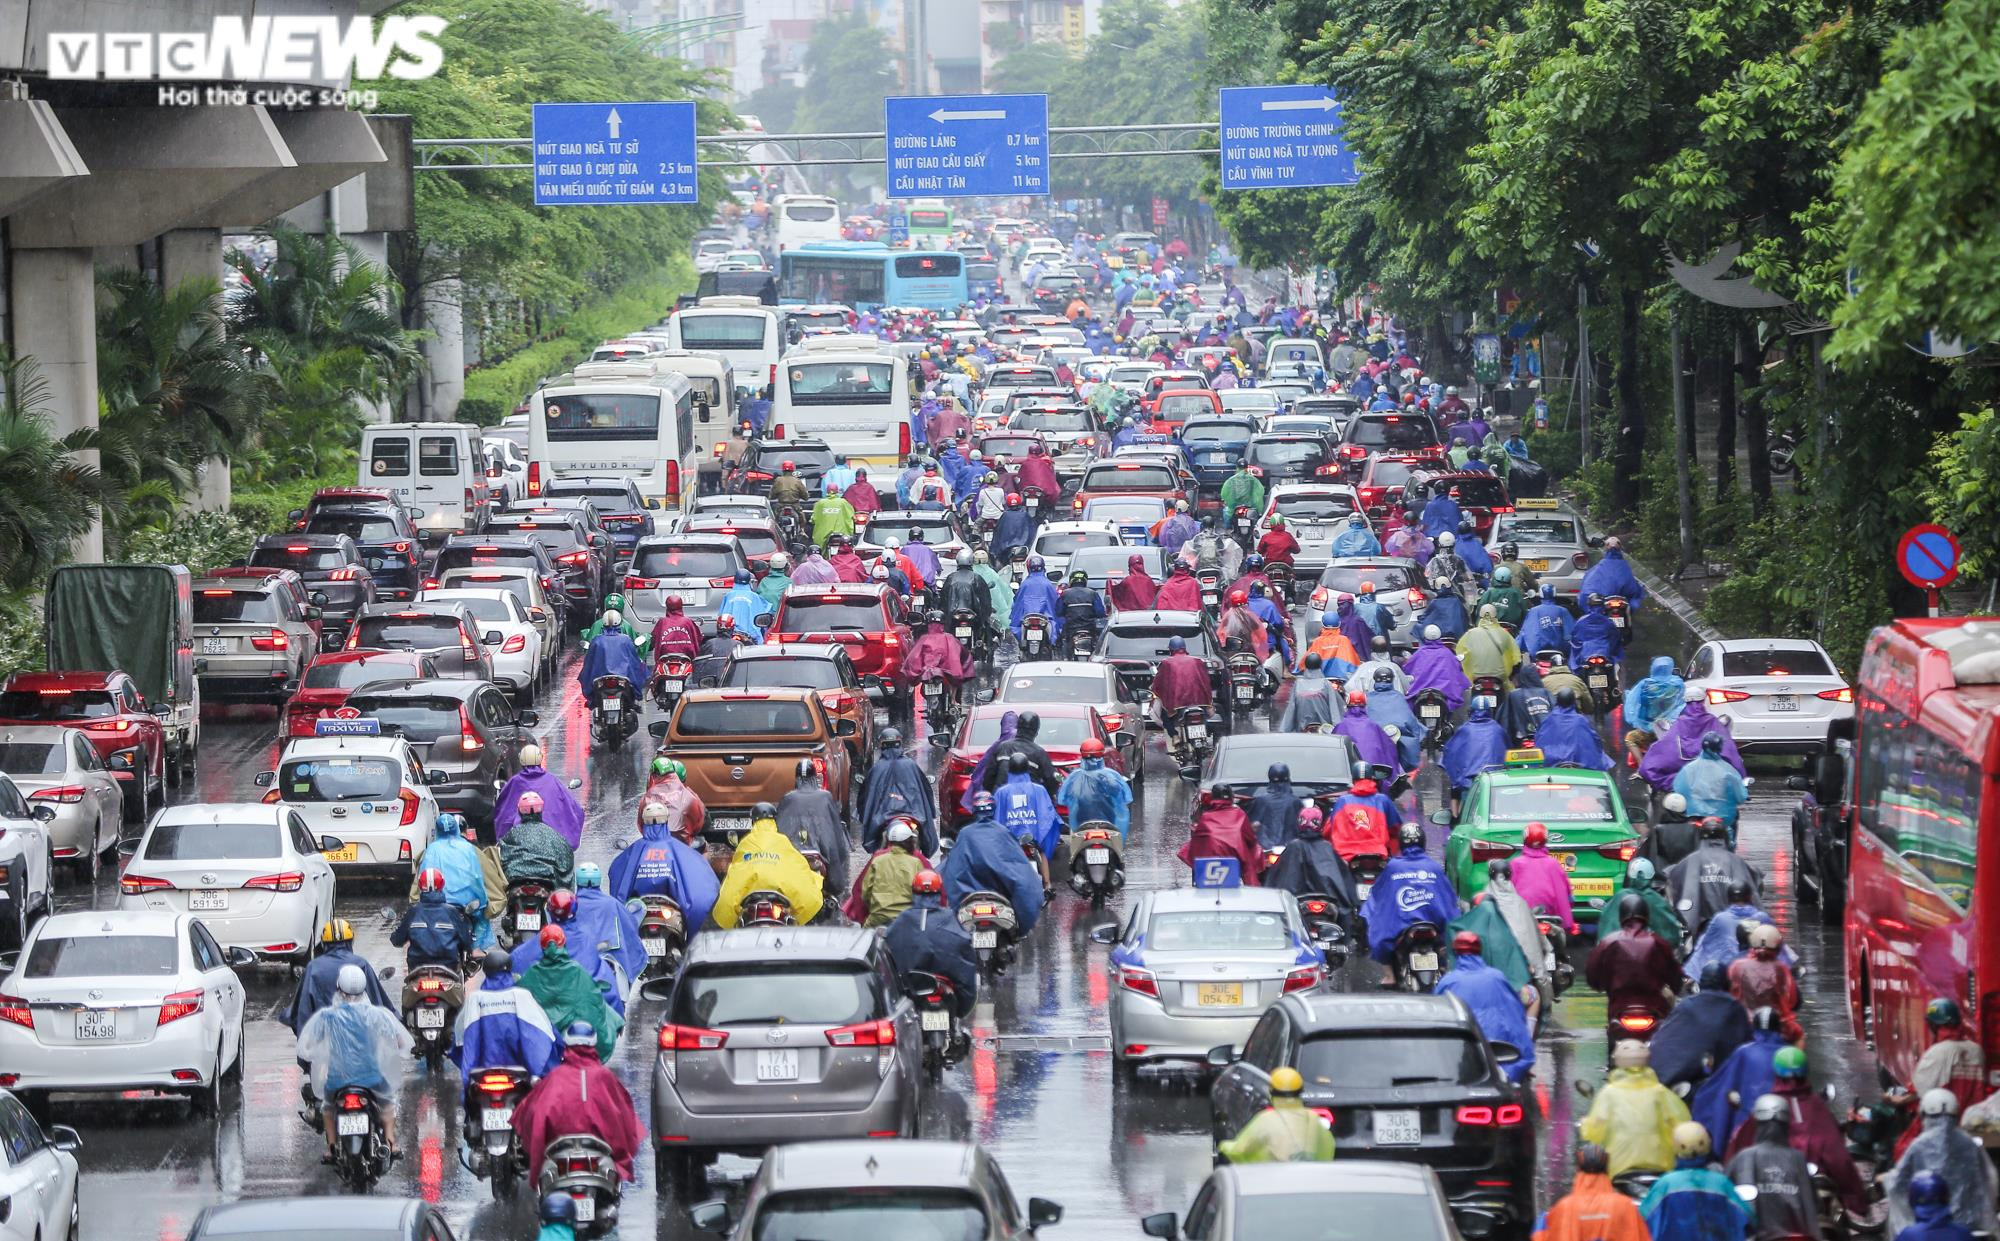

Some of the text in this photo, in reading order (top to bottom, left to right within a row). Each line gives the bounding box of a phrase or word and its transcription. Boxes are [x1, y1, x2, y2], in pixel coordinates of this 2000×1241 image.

[1226, 121, 1334, 140] ĐƯỜNG TRƯỜNG CHINH
[538, 138, 640, 155] NÚT GIAO NGÃ TƯ SỞ
[894, 132, 957, 149] ĐƯỜNG LÁNG
[1024, 134, 1040, 146] km
[1227, 143, 1338, 160] NÚT GIAO NGÃ TƯ VỌNG
[895, 151, 986, 169] NÚT GIAO CẦU GIẤY
[1015, 154, 1040, 167] 5 km
[539, 161, 557, 176] NÚT
[560, 164, 582, 175] GIAO
[586, 161, 593, 175] Ô
[596, 163, 616, 177] CHỢ
[678, 162, 693, 174] km
[1228, 165, 1295, 181] CẦU VĨNH TUY
[540, 181, 559, 196] VĂN
[561, 179, 584, 196] MIẾU
[586, 179, 612, 195] QUỐC
[630, 181, 655, 195] GIÁM
[896, 173, 966, 191] CẦU NHẬT TÂN
[1013, 175, 1041, 187] 11 km
[678, 183, 693, 194] km
[1007, 810, 1036, 819] AVIVA
[644, 848, 668, 861] JEX
[201, 890, 218, 899] 30G
[193, 900, 225, 909] 591.95
[1211, 983, 1230, 993] 30E
[1202, 994, 1239, 1004] 054.75
[86, 1012, 104, 1024] 30F
[79, 1026, 113, 1039] 154.98
[769, 1050, 788, 1062] 17A
[759, 1063, 798, 1079] 116.11
[1387, 1113, 1410, 1127] 30G
[1378, 1128, 1420, 1142] 298.33
